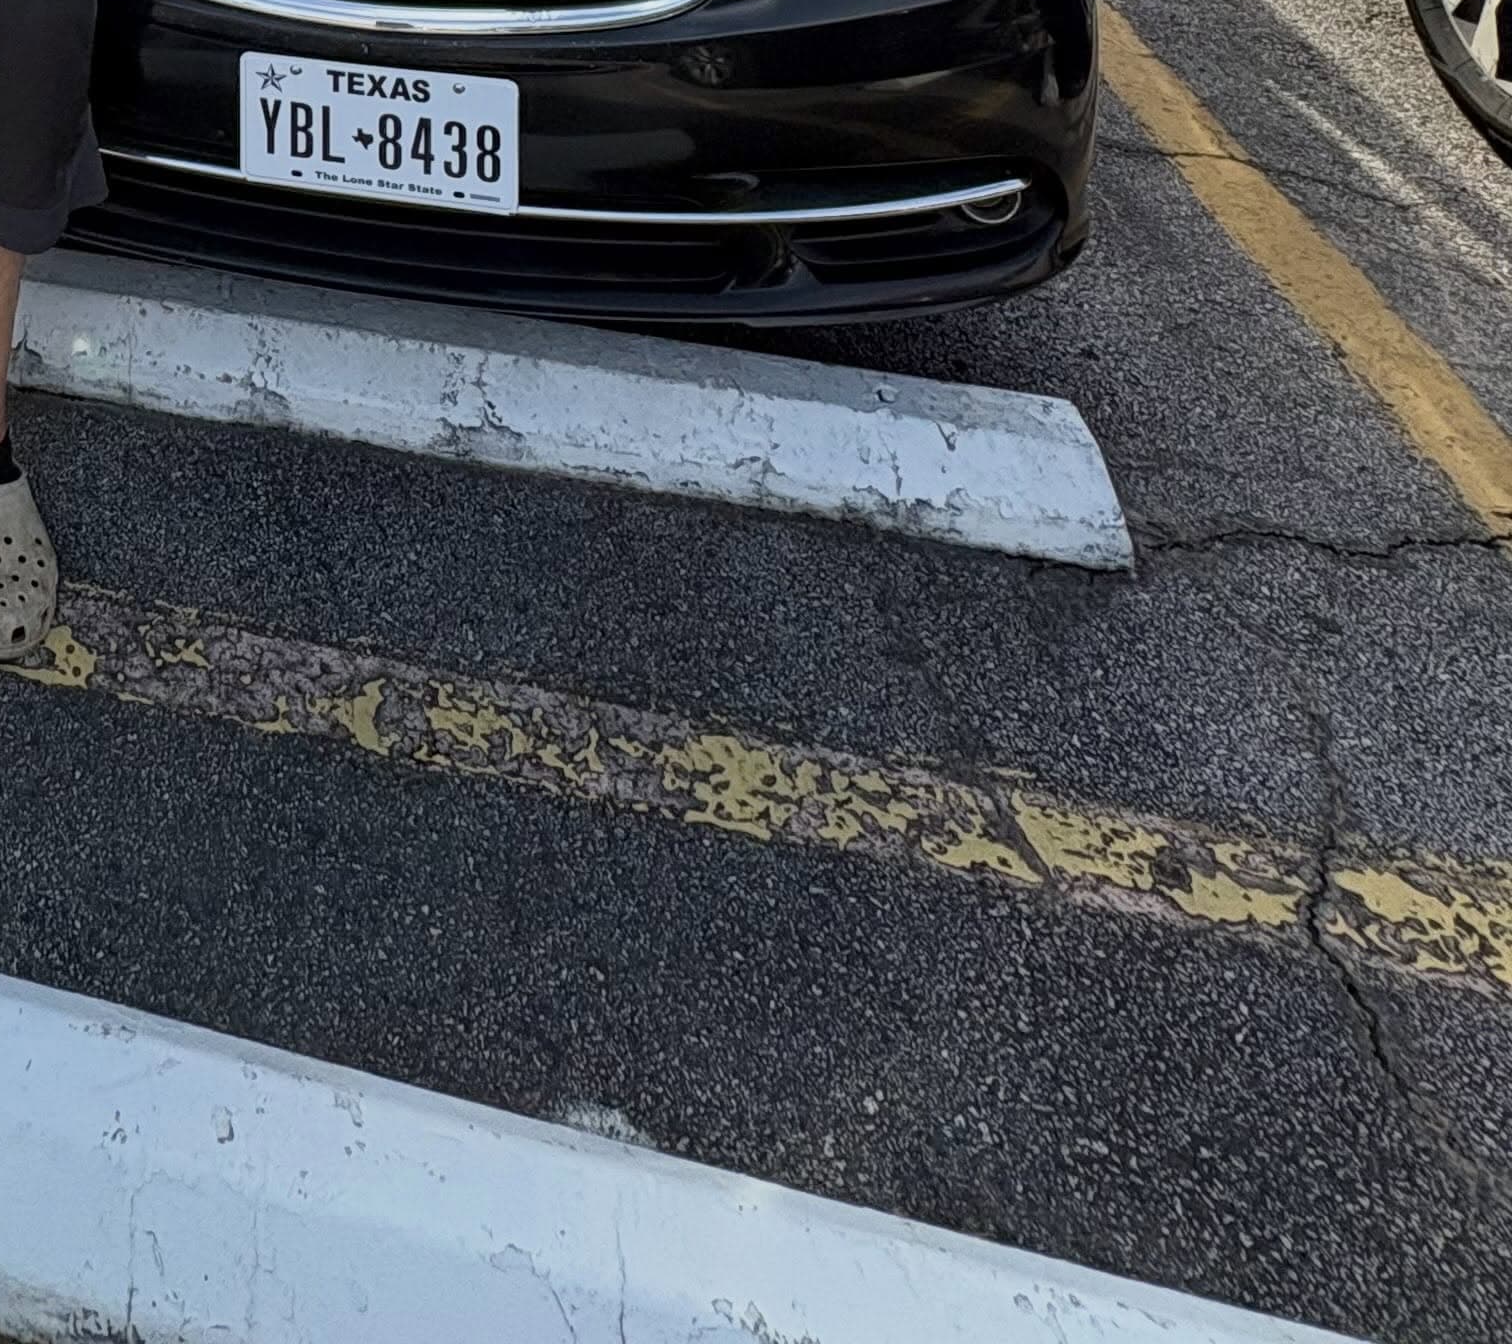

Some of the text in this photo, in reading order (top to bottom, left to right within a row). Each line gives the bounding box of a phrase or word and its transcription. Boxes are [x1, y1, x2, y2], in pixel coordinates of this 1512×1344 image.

[326, 68, 431, 103] TEXAS
[314, 170, 443, 196] The Lone Star State
